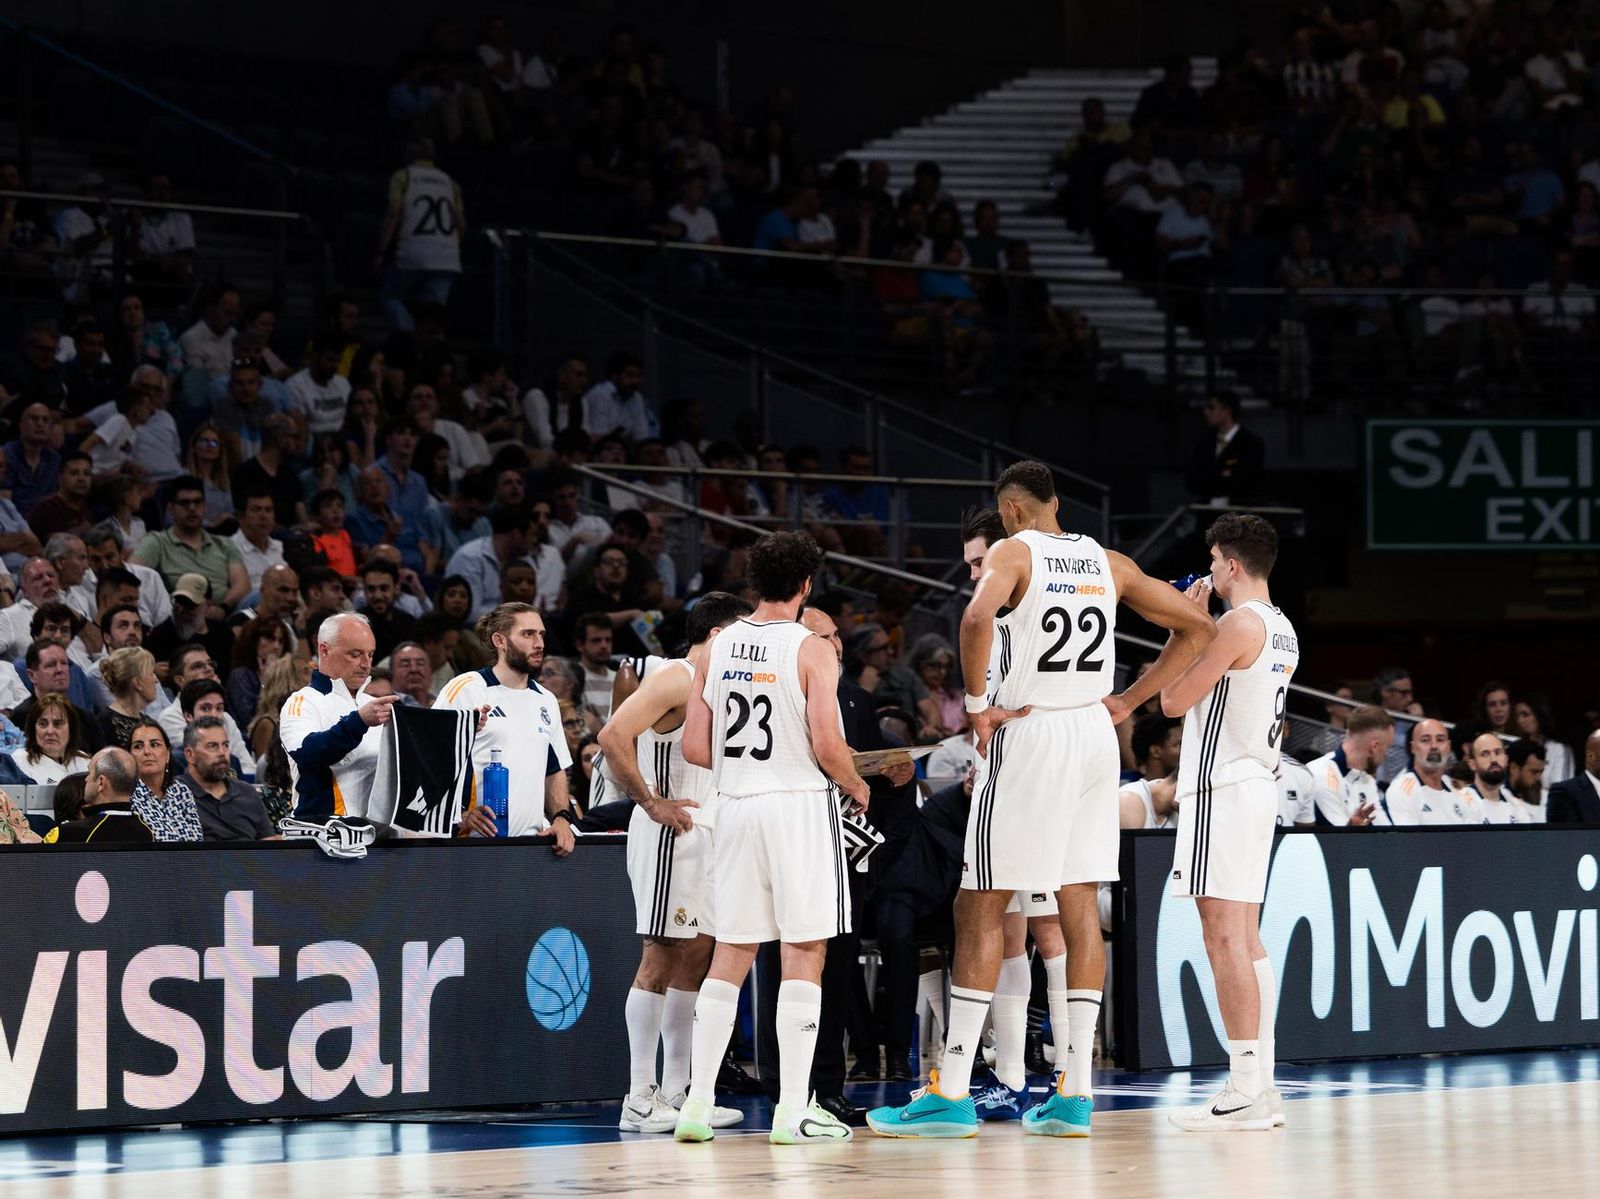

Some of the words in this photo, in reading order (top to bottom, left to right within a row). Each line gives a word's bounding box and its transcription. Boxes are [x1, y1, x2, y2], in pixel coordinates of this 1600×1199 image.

[412, 194, 455, 235] 20
[1389, 428, 1593, 488] SALI
[1487, 497, 1600, 541] EXI
[1044, 557, 1101, 575] TAVARES
[1046, 582, 1105, 596] AUTOHERO
[1037, 606, 1107, 672] 22
[724, 691, 773, 762] 23
[1268, 686, 1287, 749] 9
[1349, 854, 1599, 1032] Movi
